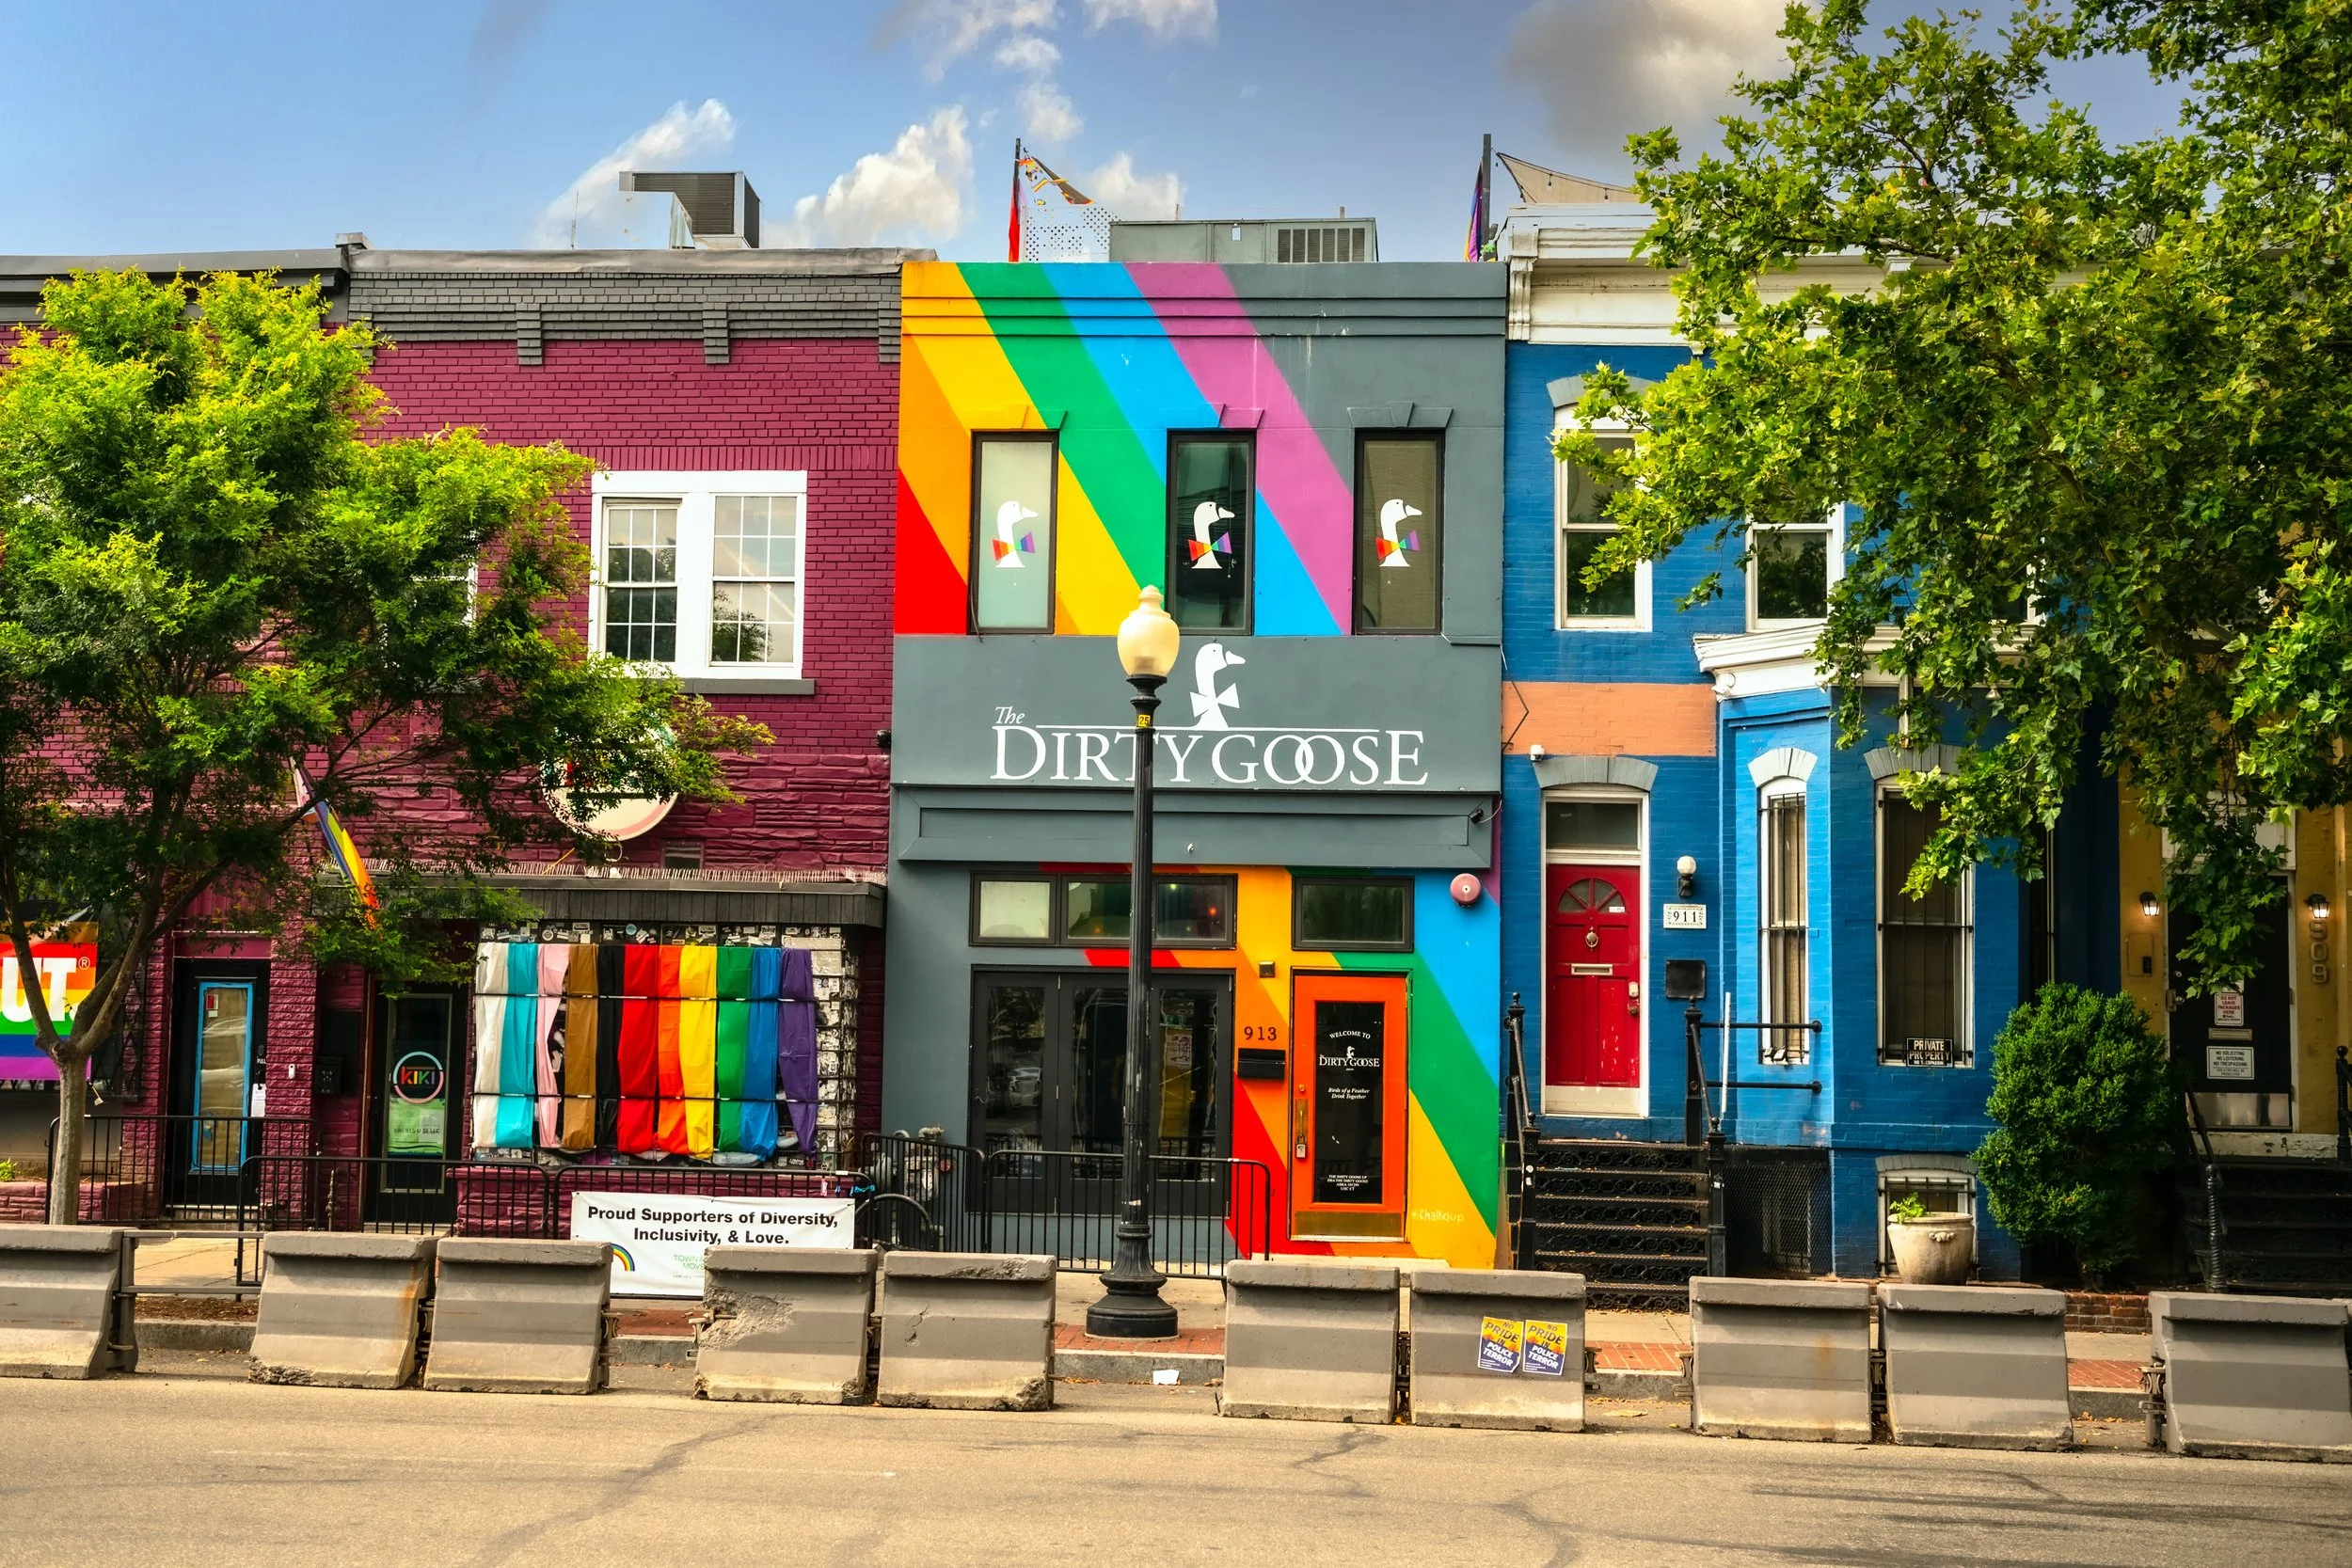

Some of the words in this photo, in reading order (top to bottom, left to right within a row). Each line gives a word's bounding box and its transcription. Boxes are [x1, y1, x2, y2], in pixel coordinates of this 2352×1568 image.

[995, 706, 1025, 724] The
[1139, 716, 1150, 725] 25
[990, 725, 1203, 783] DIRTY
[1212, 730, 1428, 784] GOOSE
[1673, 911, 1696, 923] 911
[2309, 920, 2328, 984] 909
[1244, 1025, 1277, 1041] 913
[1914, 1039, 1945, 1052] PRIVATE
[1319, 1057, 1349, 1067] DIRTY
[1349, 1058, 1380, 1067] GOOSE
[588, 1206, 636, 1220] Proud
[641, 1208, 733, 1224] Supporters
[739, 1212, 755, 1224] of
[760, 1212, 838, 1228] Diversity,
[633, 1227, 722, 1245] Inclusivity,
[727, 1230, 739, 1243] &
[745, 1230, 789, 1244] Love.
[1485, 1322, 1520, 1343] PRIDE
[1528, 1324, 1565, 1346] PRIDE
[1483, 1347, 1514, 1367] TERROR
[1486, 1341, 1514, 1358] POLICE
[1532, 1344, 1559, 1360] POLICE
[1528, 1351, 1559, 1370] TERROR
